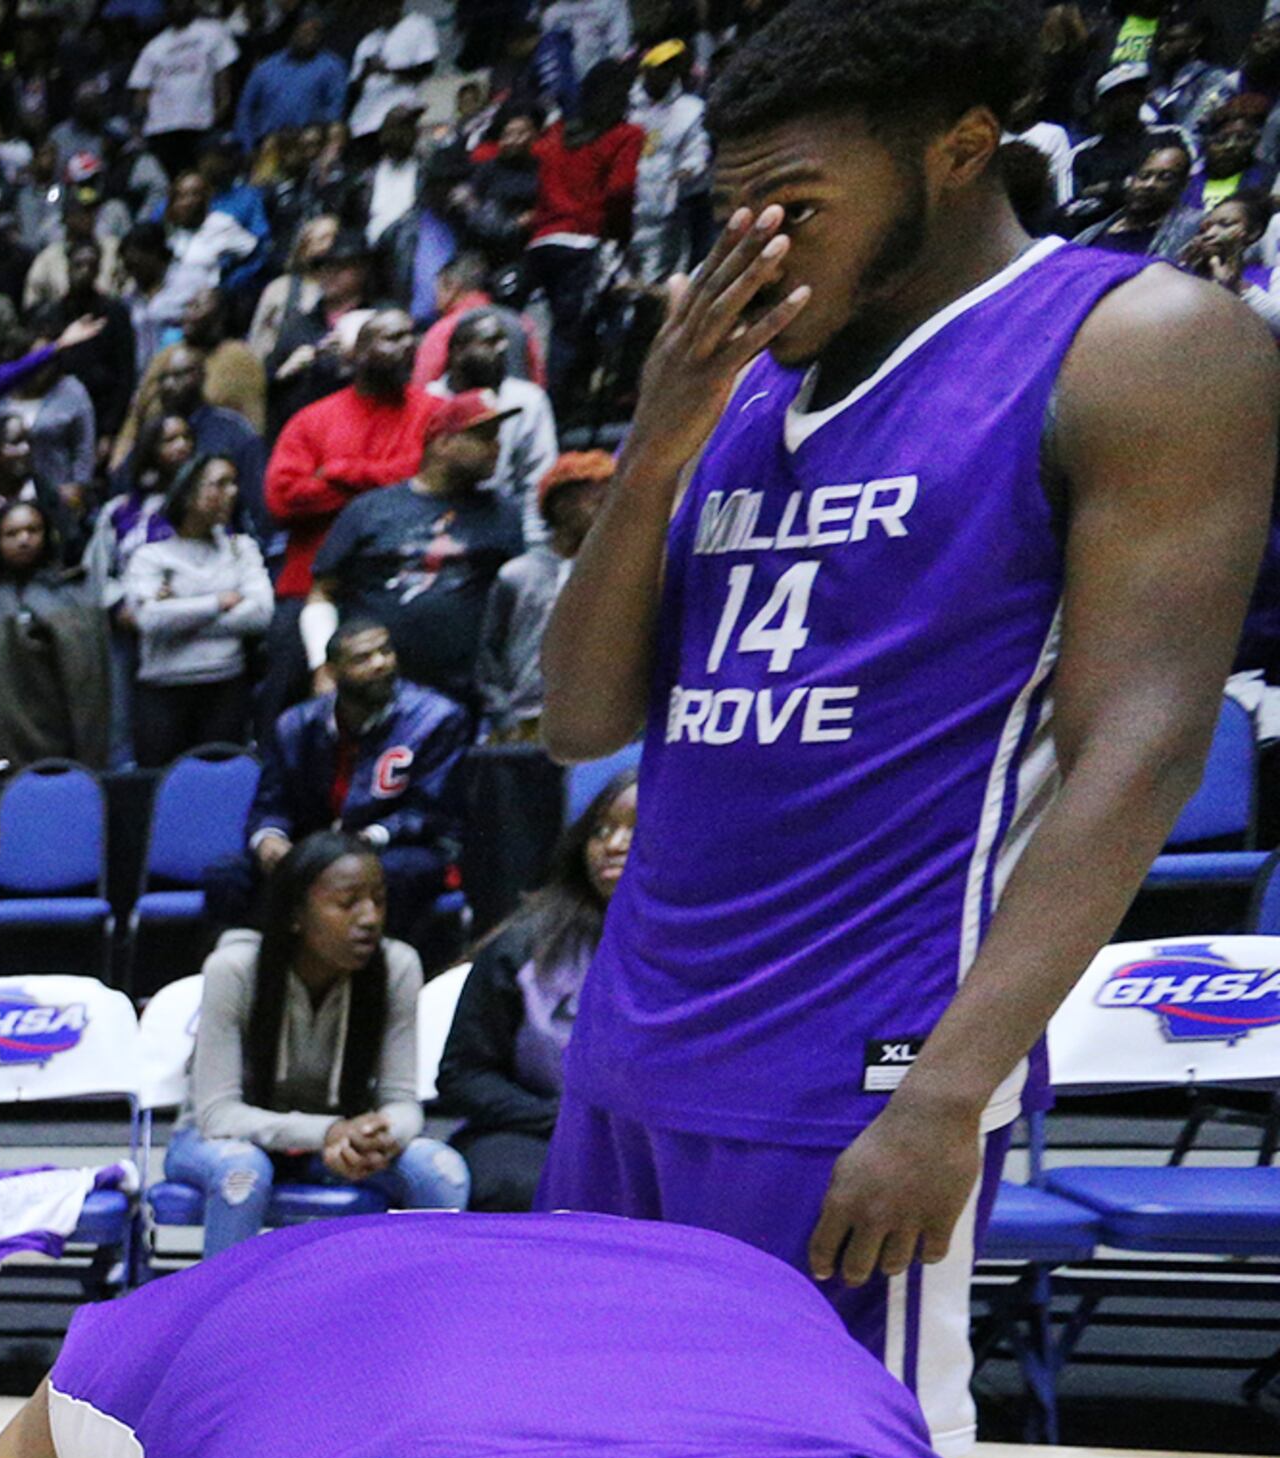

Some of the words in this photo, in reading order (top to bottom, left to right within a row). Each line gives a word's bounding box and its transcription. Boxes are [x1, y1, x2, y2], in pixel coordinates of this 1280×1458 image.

[706, 560, 822, 674] 14
[370, 744, 415, 800] C
[879, 1043, 918, 1062] XL
